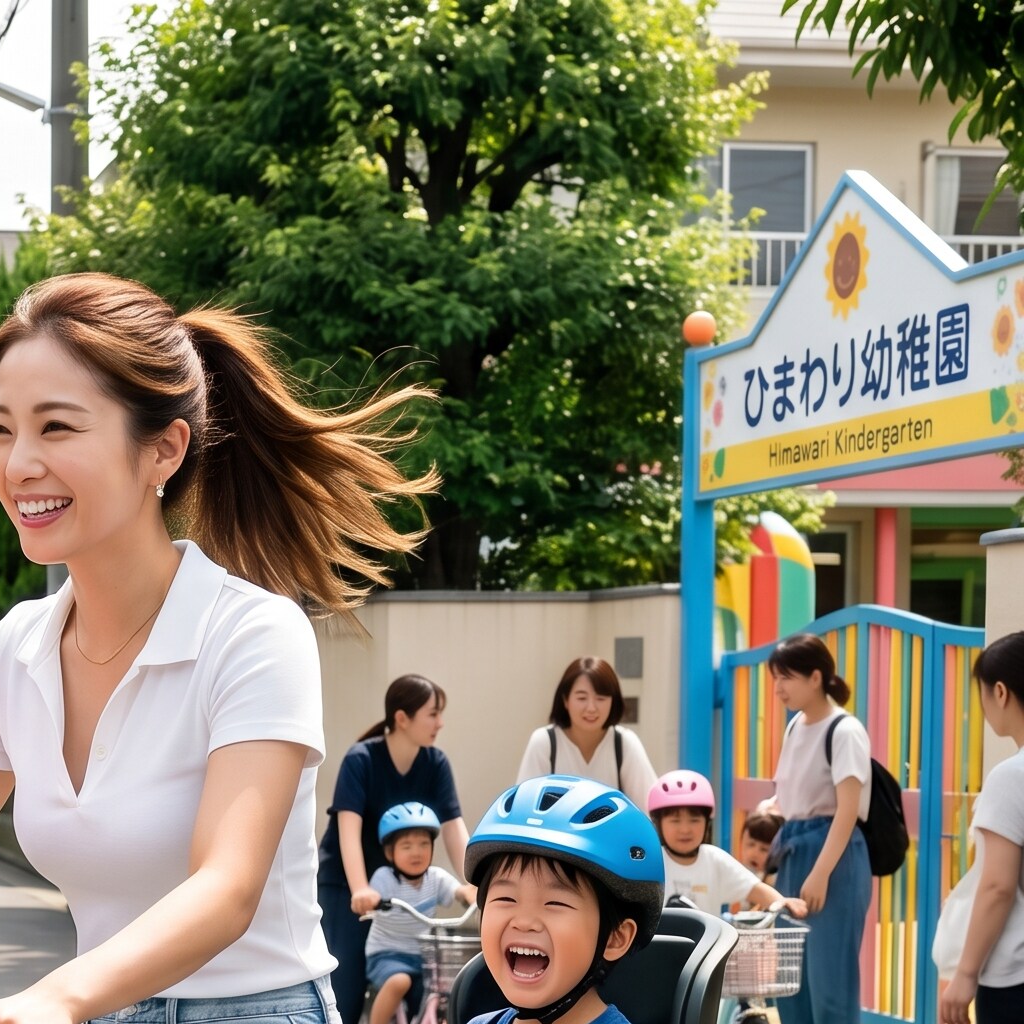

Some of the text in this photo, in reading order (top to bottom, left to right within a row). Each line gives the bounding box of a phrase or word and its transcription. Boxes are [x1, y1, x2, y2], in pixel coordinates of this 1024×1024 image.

[743, 302, 970, 428] ひまわり幼稚園
[769, 417, 933, 468] Himawari Kindergarten
